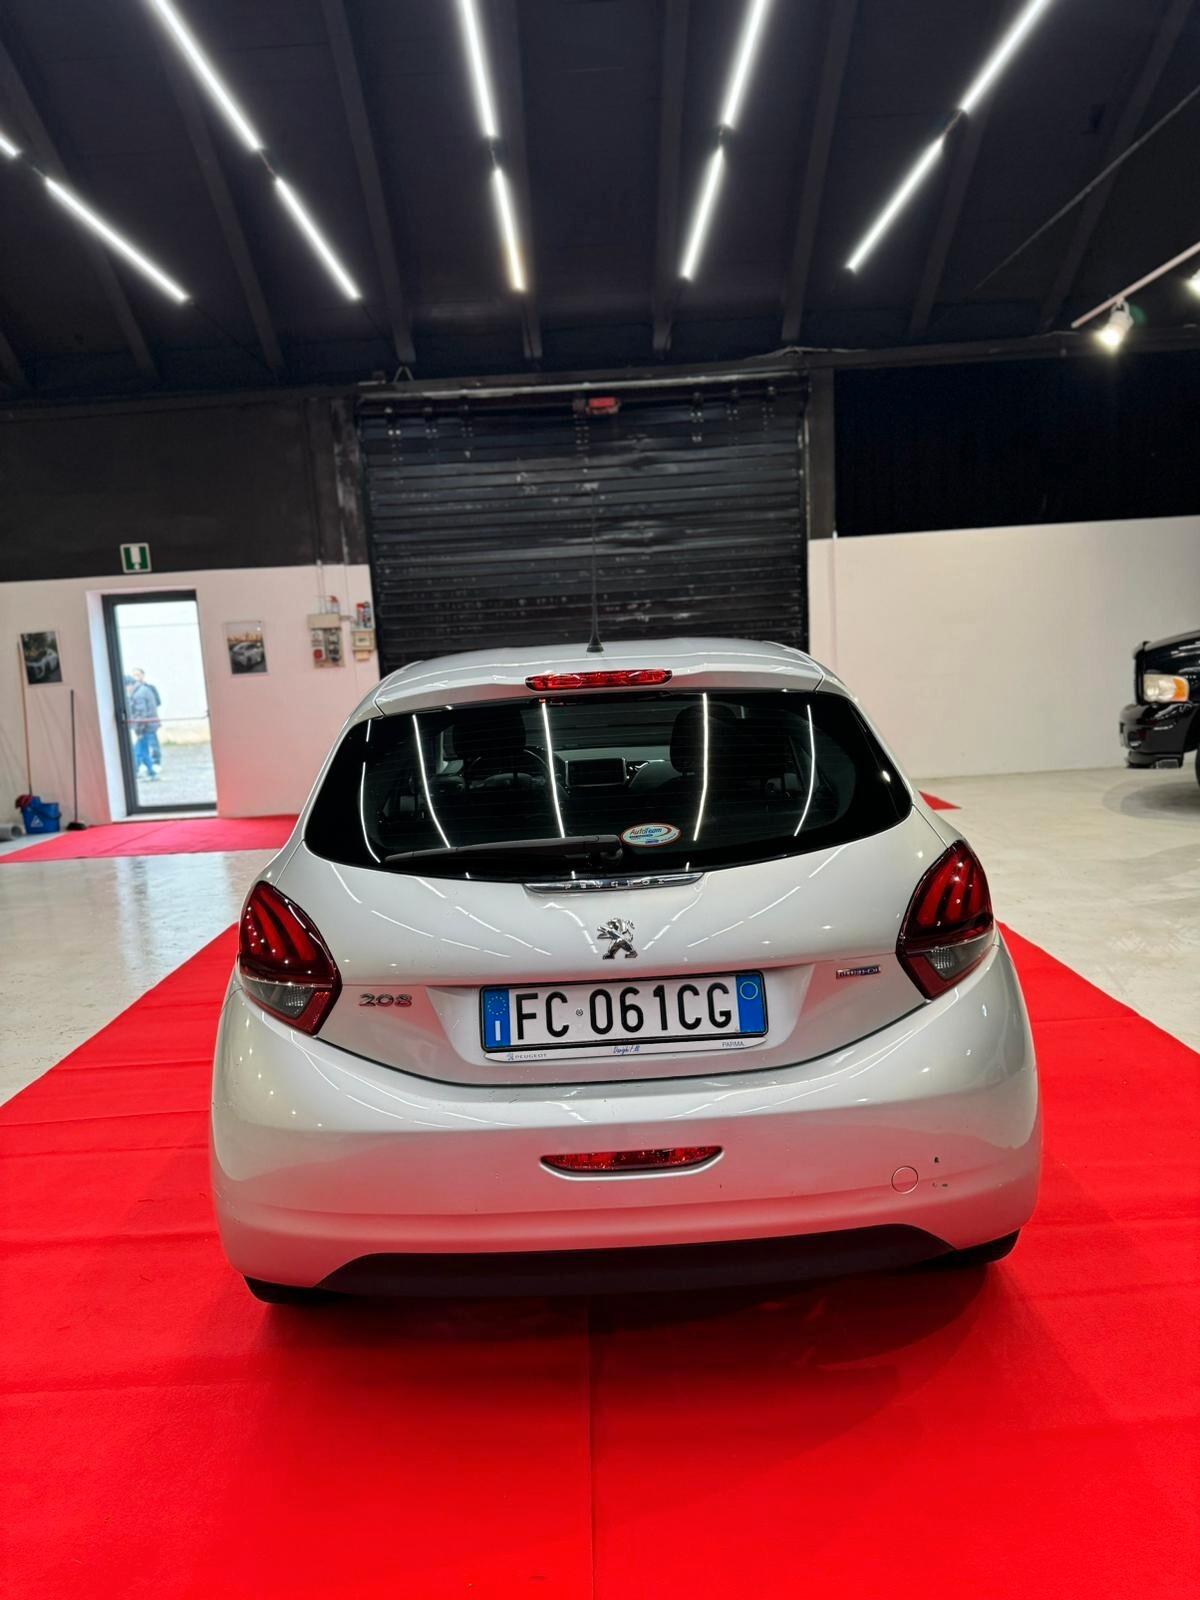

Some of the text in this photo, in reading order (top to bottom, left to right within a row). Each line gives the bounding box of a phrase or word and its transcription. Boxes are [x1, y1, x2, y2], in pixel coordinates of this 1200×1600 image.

[359, 993, 413, 1008] 208
[515, 982, 732, 1040] FC 061CG
